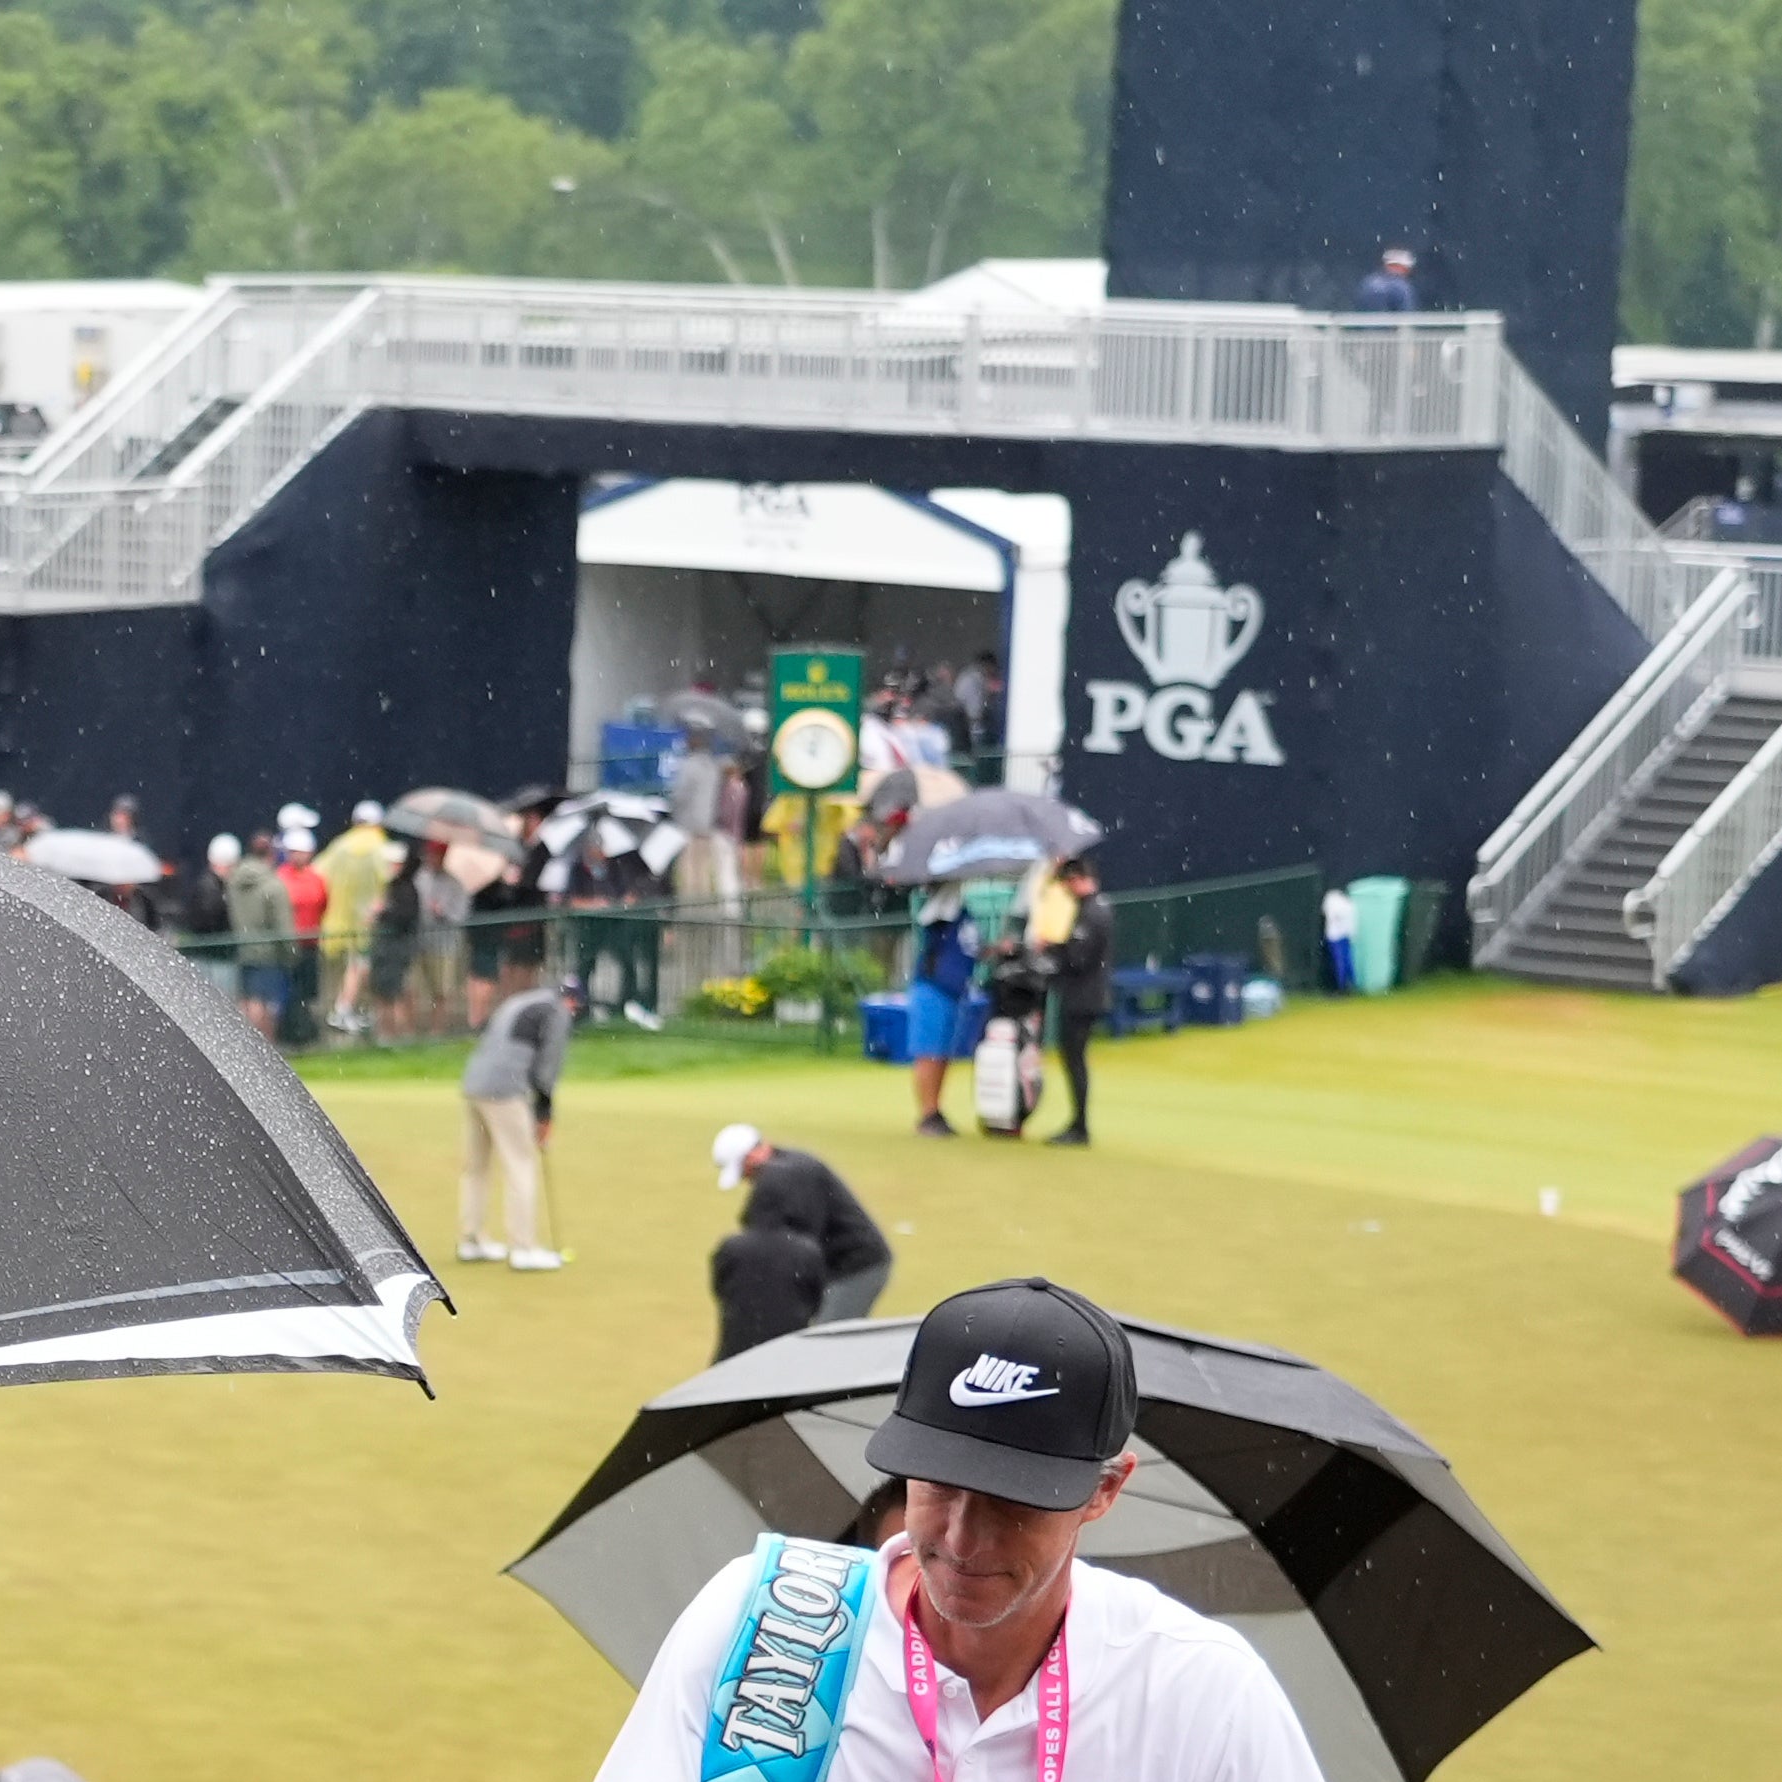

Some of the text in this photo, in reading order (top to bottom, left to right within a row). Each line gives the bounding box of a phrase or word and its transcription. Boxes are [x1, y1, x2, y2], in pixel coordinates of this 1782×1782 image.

[1082, 680, 1285, 767] PGA
[965, 1353, 1040, 1393] NIKE
[1046, 1681, 1062, 1722] ALL
